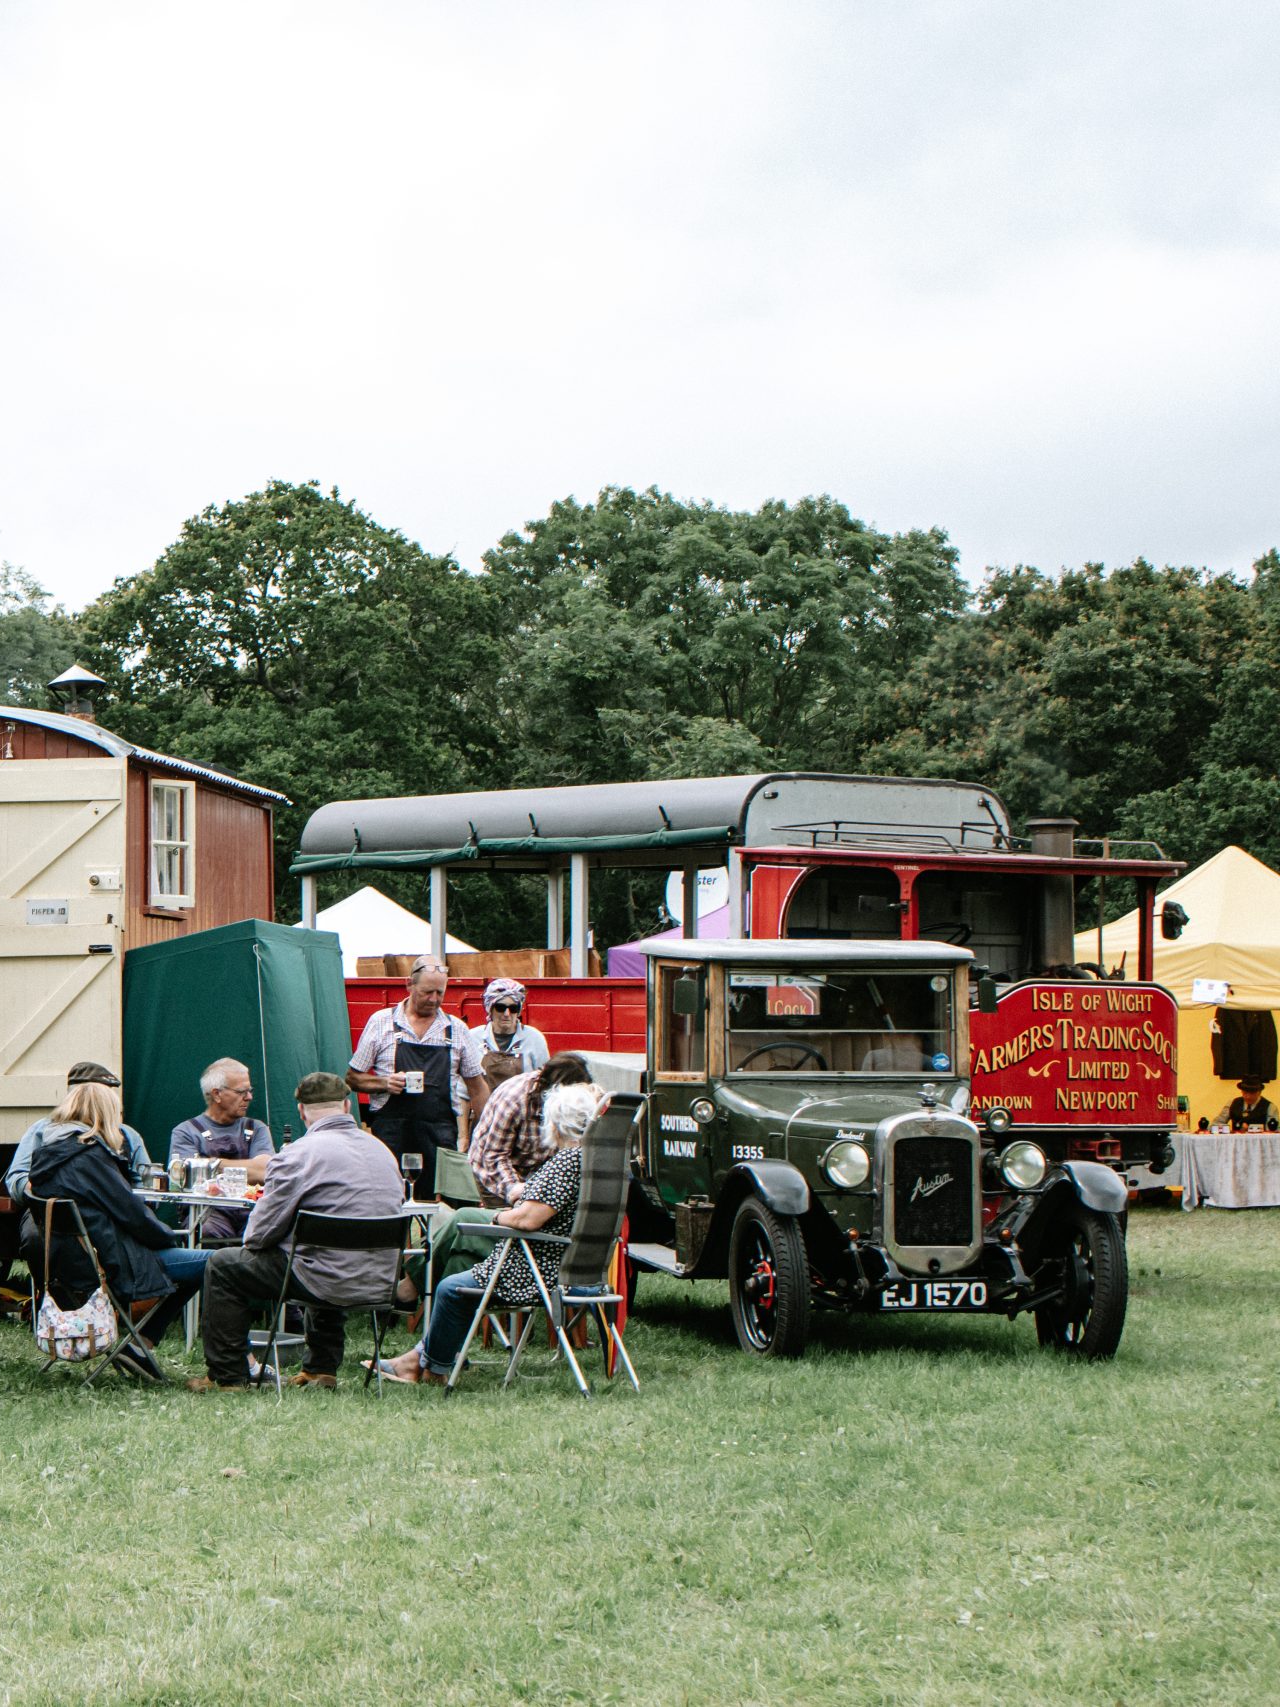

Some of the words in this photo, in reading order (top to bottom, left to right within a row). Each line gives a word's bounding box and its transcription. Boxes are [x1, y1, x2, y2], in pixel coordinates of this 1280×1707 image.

[697, 876, 717, 886] ster
[1032, 988, 1074, 1011] ISLE
[1081, 994, 1102, 1011] OF
[1106, 989, 1154, 1012] WIGHT
[1056, 1018, 1141, 1050] TRADING
[1067, 1056, 1130, 1080] LIMITED
[970, 1095, 1033, 1110] ANDOWN
[1056, 1087, 1139, 1110] NEWPORT
[1157, 1094, 1178, 1110] SHA
[661, 1114, 699, 1133] SOUTHERN
[664, 1139, 697, 1158] RAILWAY
[910, 1172, 954, 1202] Austin
[882, 1283, 918, 1307] EJ
[923, 1281, 987, 1307] 1570
